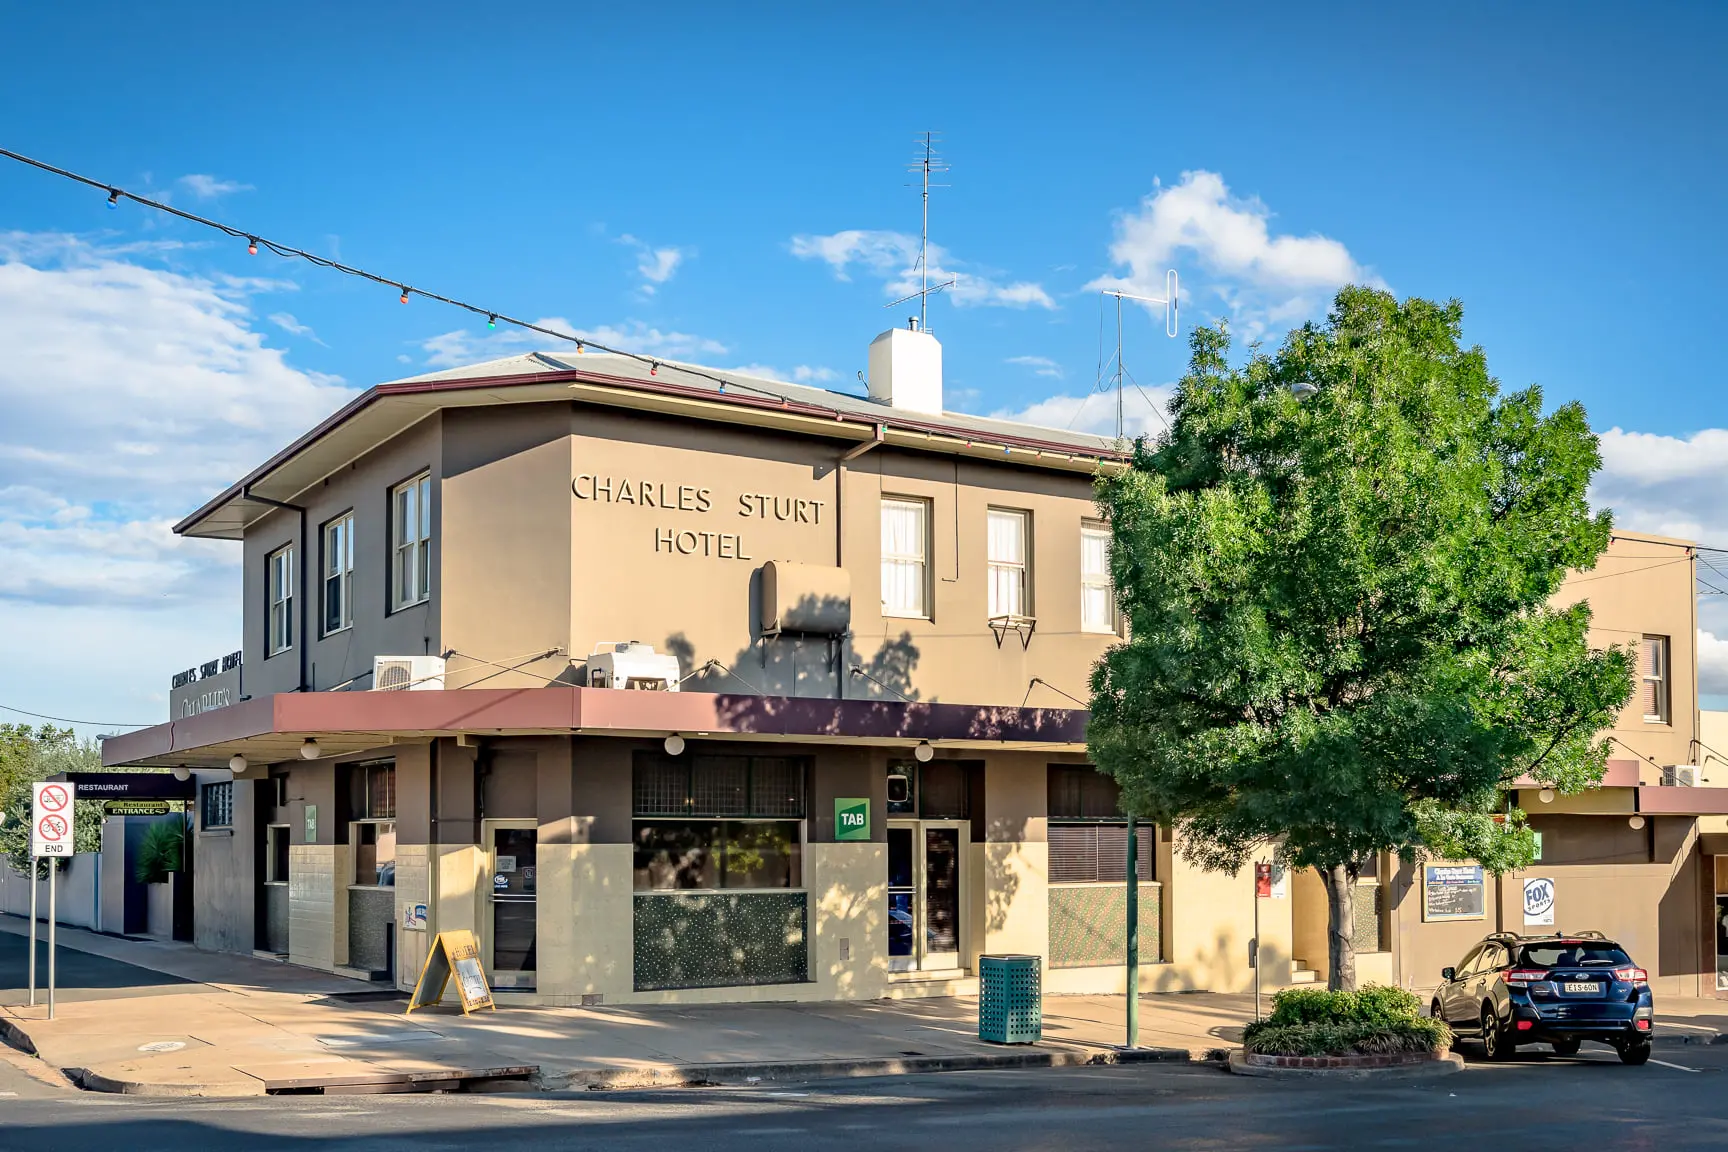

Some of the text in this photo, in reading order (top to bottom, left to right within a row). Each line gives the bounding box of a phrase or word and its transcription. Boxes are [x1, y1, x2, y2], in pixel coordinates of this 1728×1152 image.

[572, 473, 824, 525] CHARLES STURT
[655, 527, 752, 561] HOTEL
[841, 813, 864, 826] TAB
[45, 844, 64, 853] END
[1525, 882, 1550, 906] FOX
[1527, 898, 1551, 912] SPORTS
